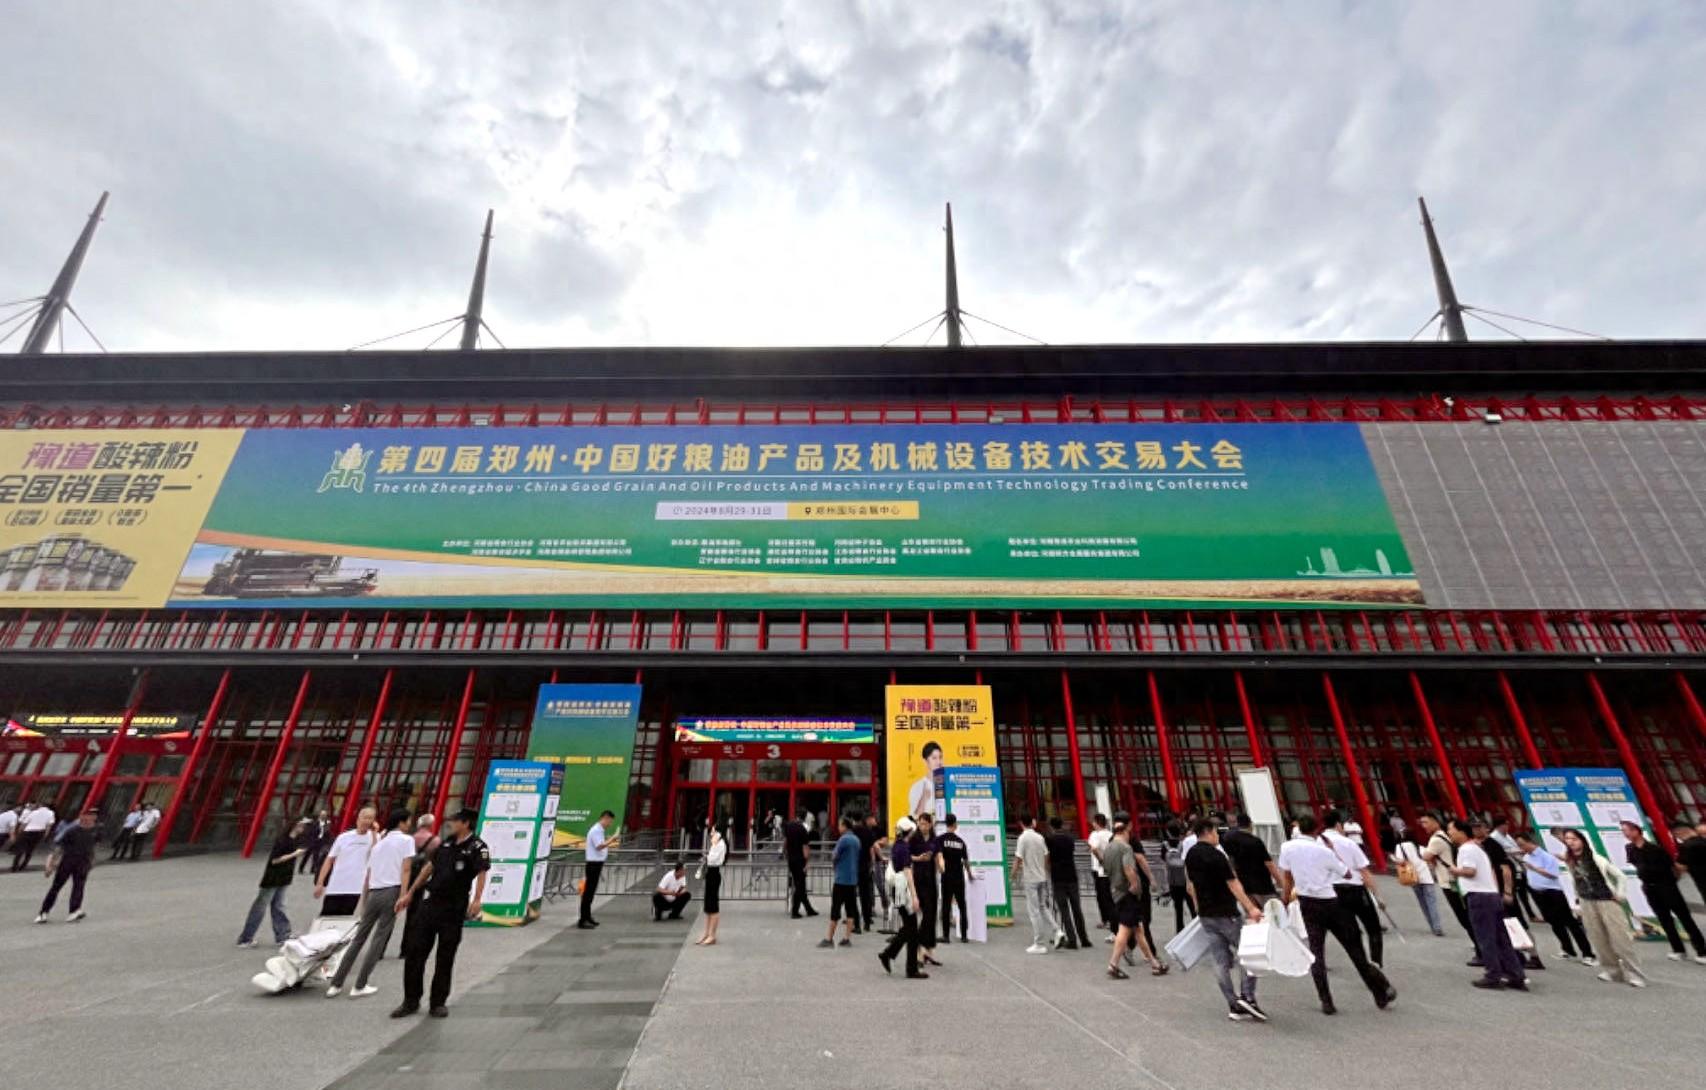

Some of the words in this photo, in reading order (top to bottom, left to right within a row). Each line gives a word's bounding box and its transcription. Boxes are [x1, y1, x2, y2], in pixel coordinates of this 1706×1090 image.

[21, 441, 199, 470] 豫道酸辣粉
[0, 474, 192, 503] 全国销量第一
[373, 482, 399, 493] The
[402, 482, 427, 493] 4th
[430, 482, 513, 495] Zhengzhou
[523, 481, 568, 492] China
[571, 481, 610, 492] Good
[613, 481, 654, 492] Grain
[658, 481, 686, 491] And
[690, 481, 712, 491] Oil
[716, 481, 786, 491] Products
[789, 481, 818, 491] And
[822, 481, 903, 492] Machinery
[907, 480, 993, 492] Equipment
[996, 480, 1088, 493] Technology
[1092, 479, 1153, 491] Trading
[1157, 479, 1249, 490] Conference
[767, 744, 781, 759] 3
